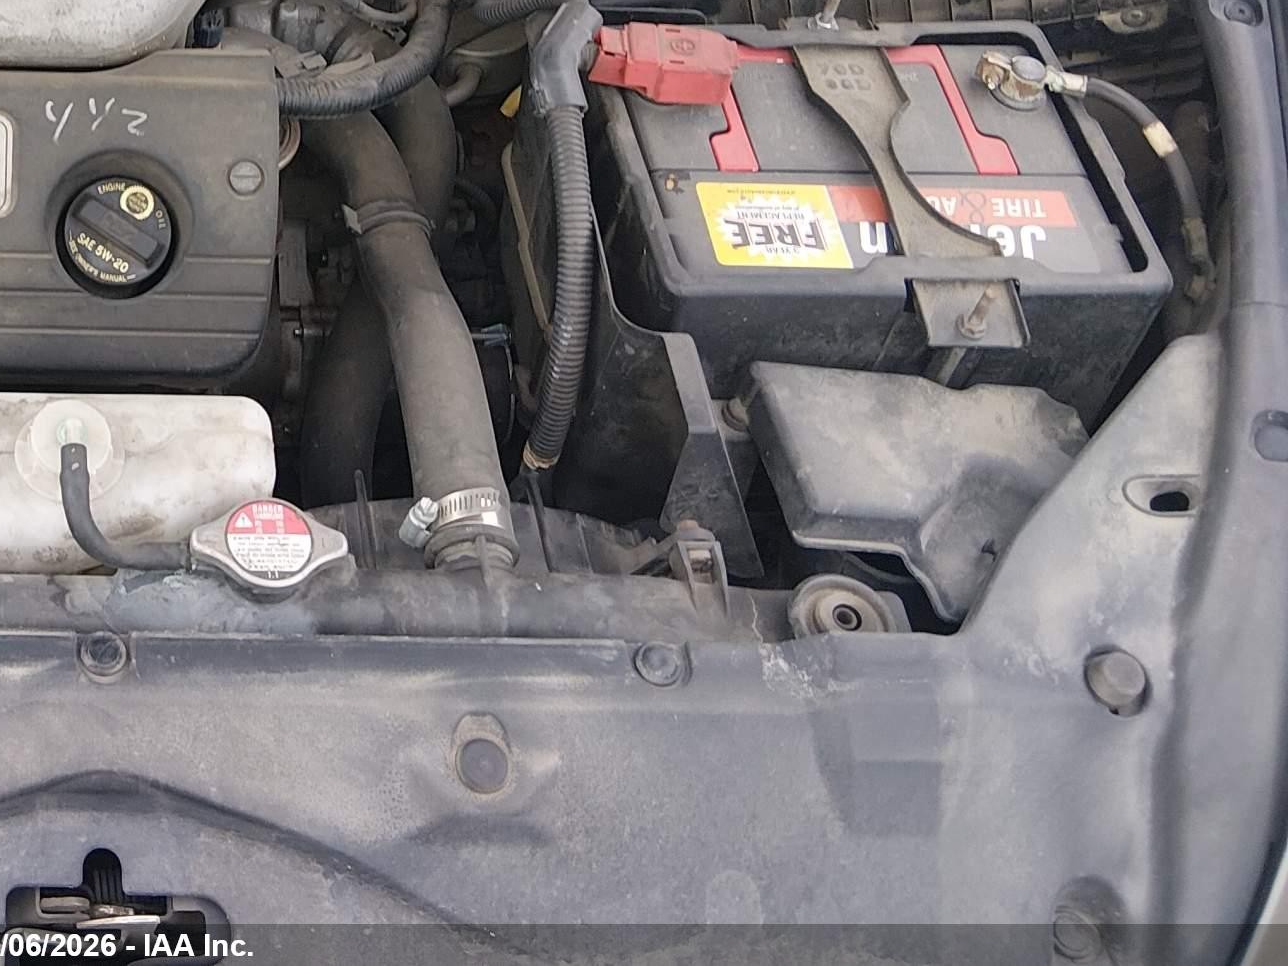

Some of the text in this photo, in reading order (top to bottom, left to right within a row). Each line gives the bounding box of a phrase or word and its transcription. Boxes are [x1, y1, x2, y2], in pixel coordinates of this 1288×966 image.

[97, 183, 125, 194] ENGINE
[991, 197, 1047, 219] TIRE
[155, 210, 168, 229] OIL
[723, 218, 827, 251] FREE
[76, 232, 129, 274] SAE 5W-20
[100, 271, 128, 283] MANUAL
